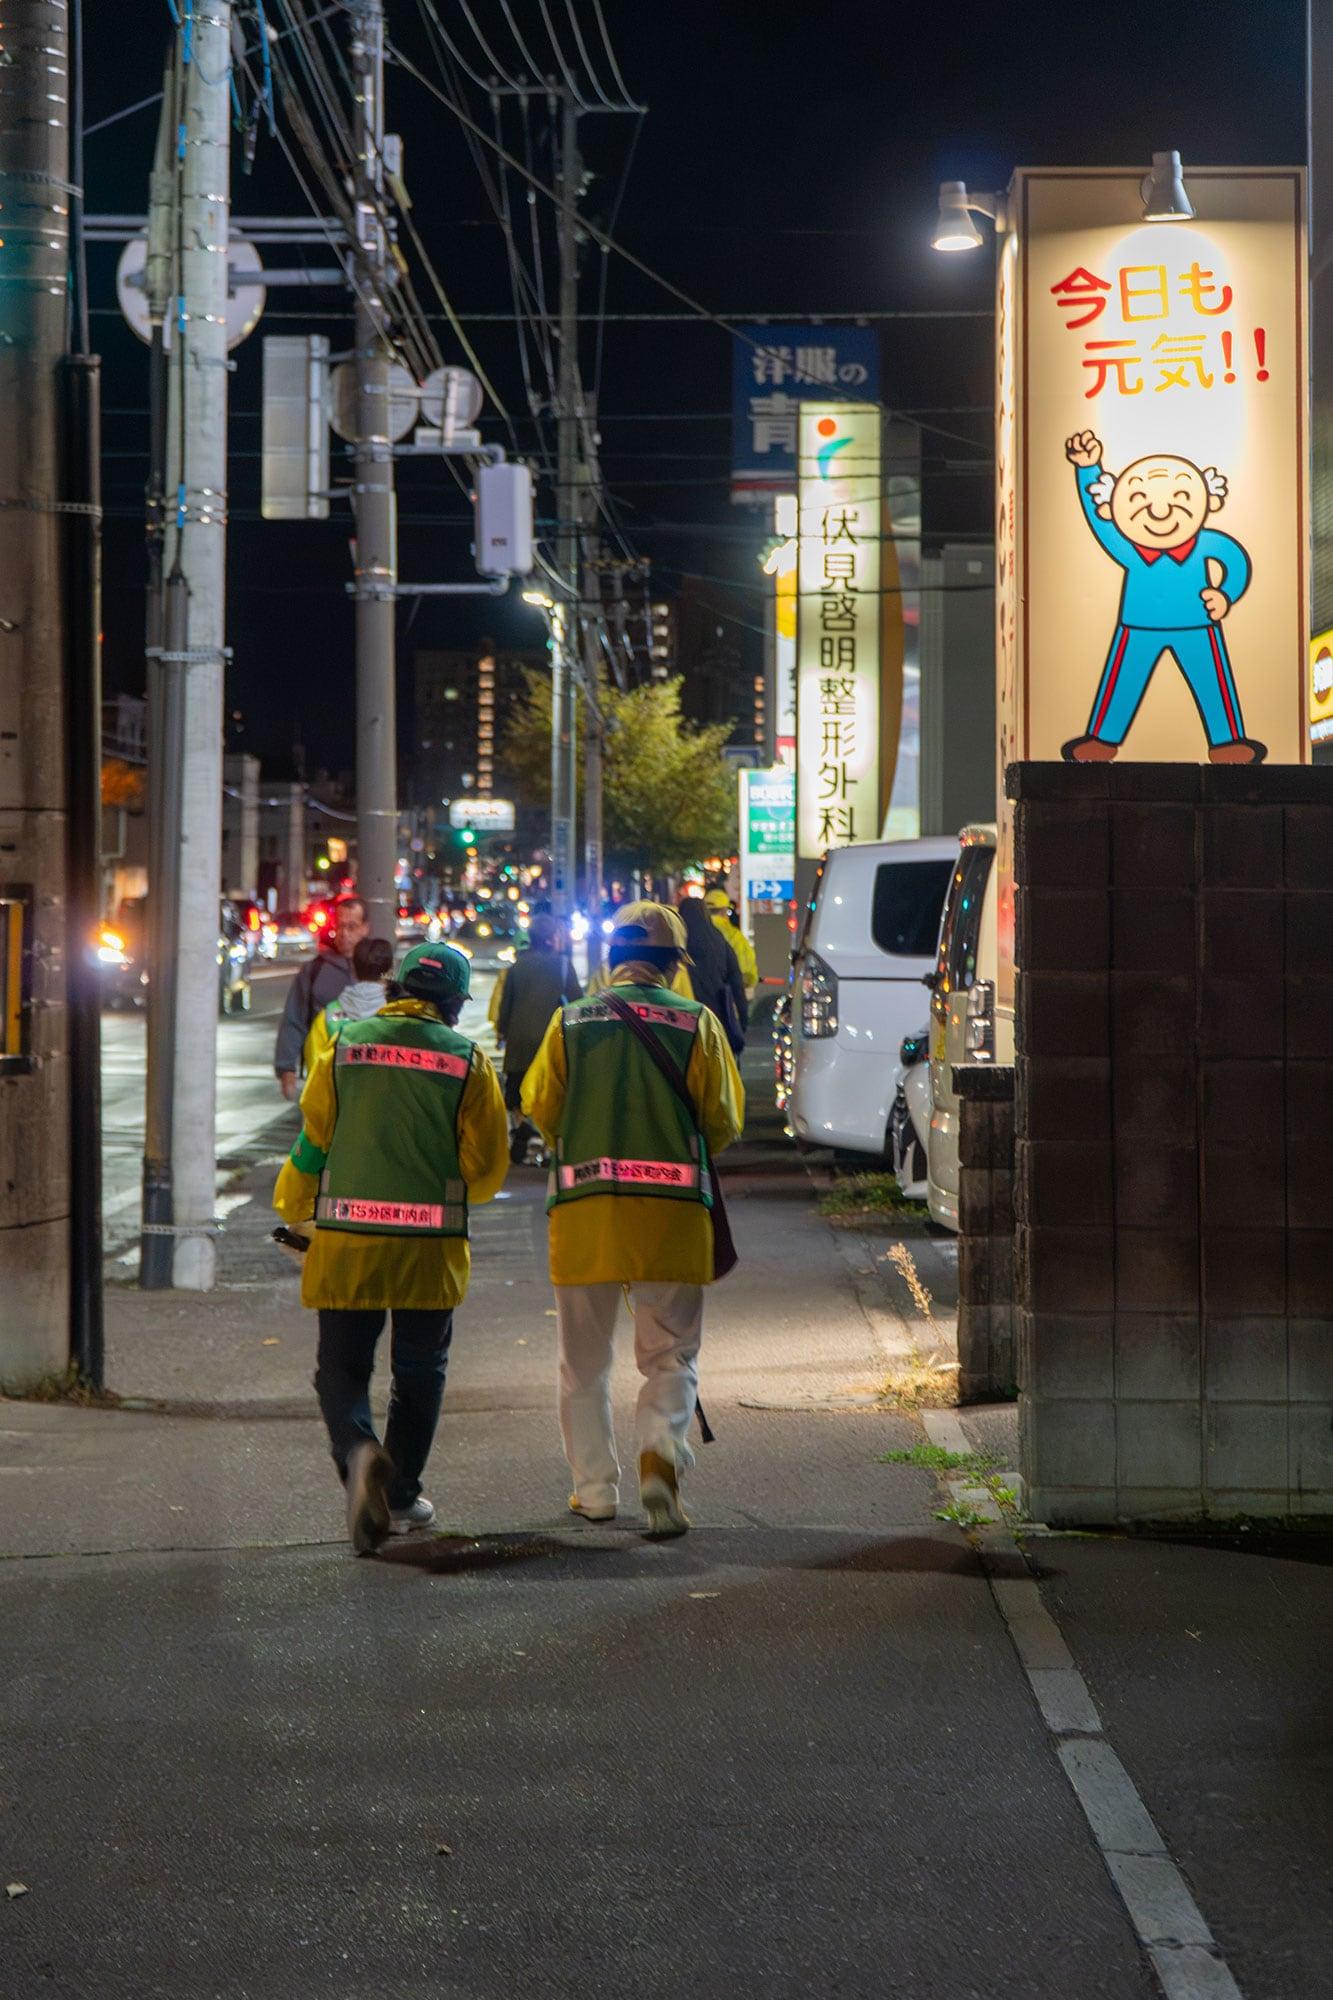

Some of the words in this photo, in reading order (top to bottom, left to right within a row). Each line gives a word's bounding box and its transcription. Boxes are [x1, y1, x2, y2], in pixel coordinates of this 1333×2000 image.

[1050, 262, 1233, 330] 今日も
[752, 345, 868, 385] 洋服の
[818, 509, 858, 843] 伏見啓明整形外科
